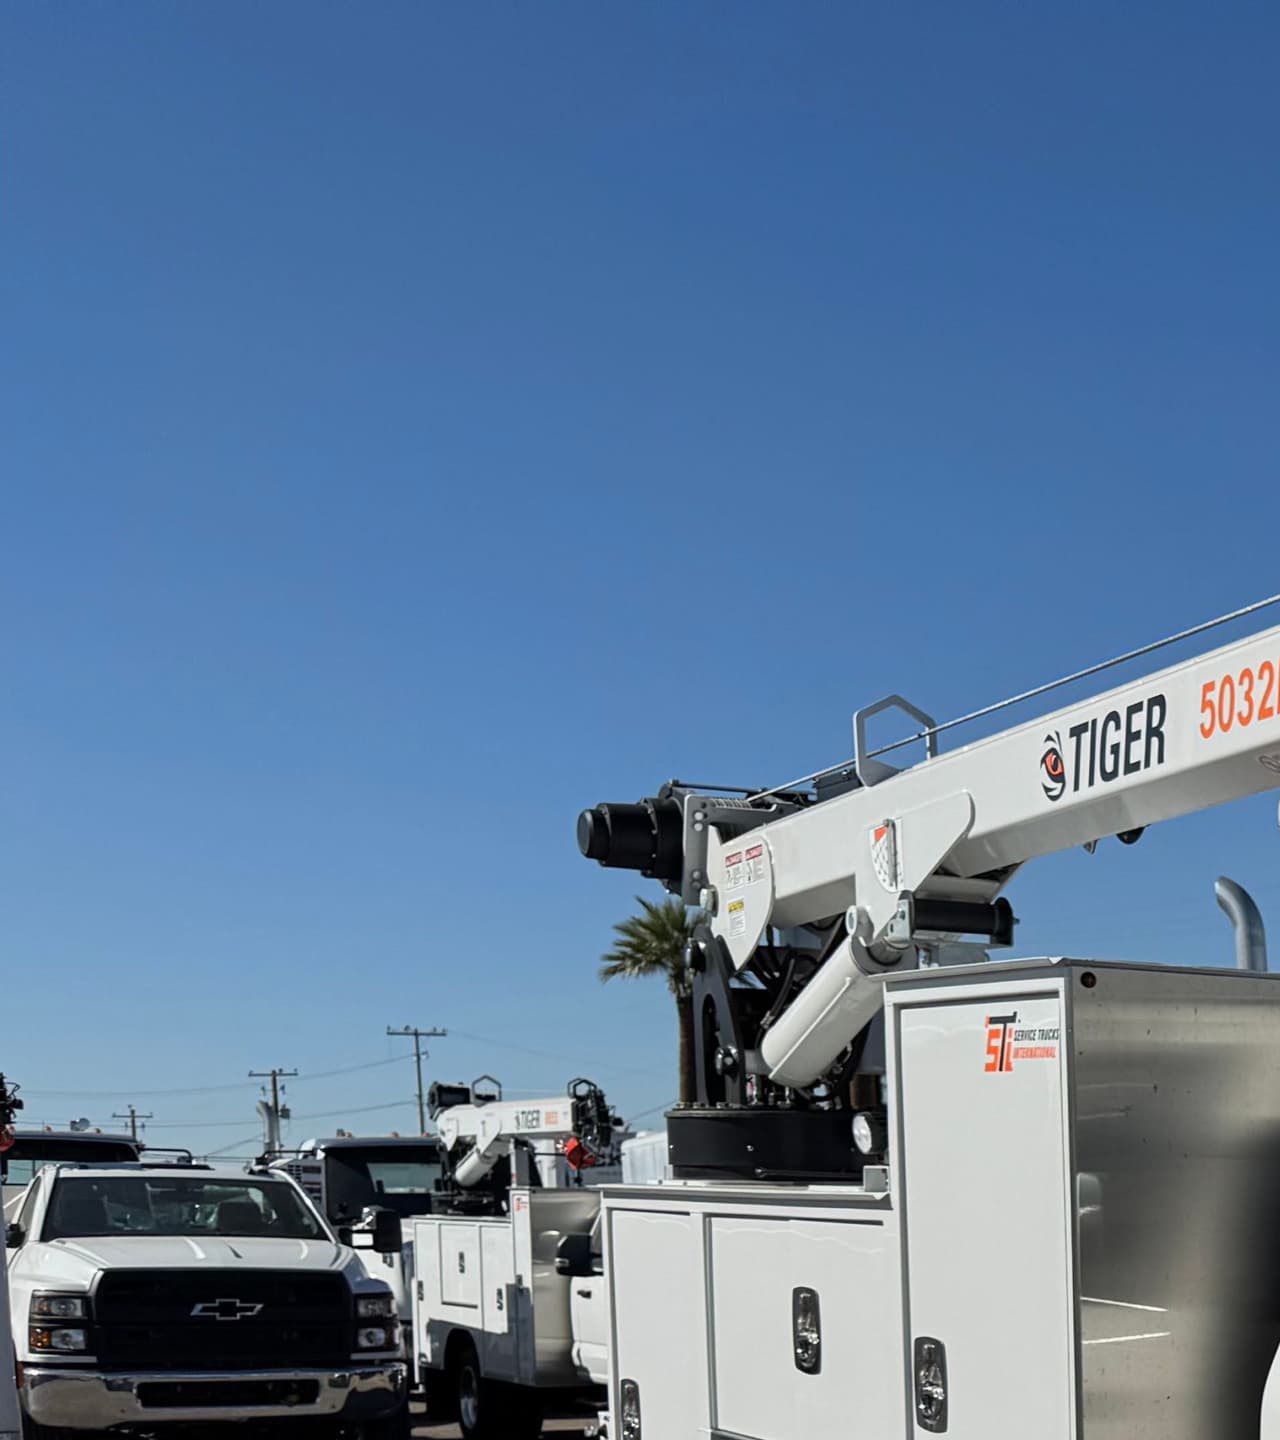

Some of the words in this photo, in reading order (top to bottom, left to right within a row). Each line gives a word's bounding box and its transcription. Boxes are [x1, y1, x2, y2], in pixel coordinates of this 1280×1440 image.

[1069, 693, 1167, 792] TIGER
[1014, 1029, 1037, 1042] SERVICE
[1038, 1028, 1060, 1041] TRUCKS
